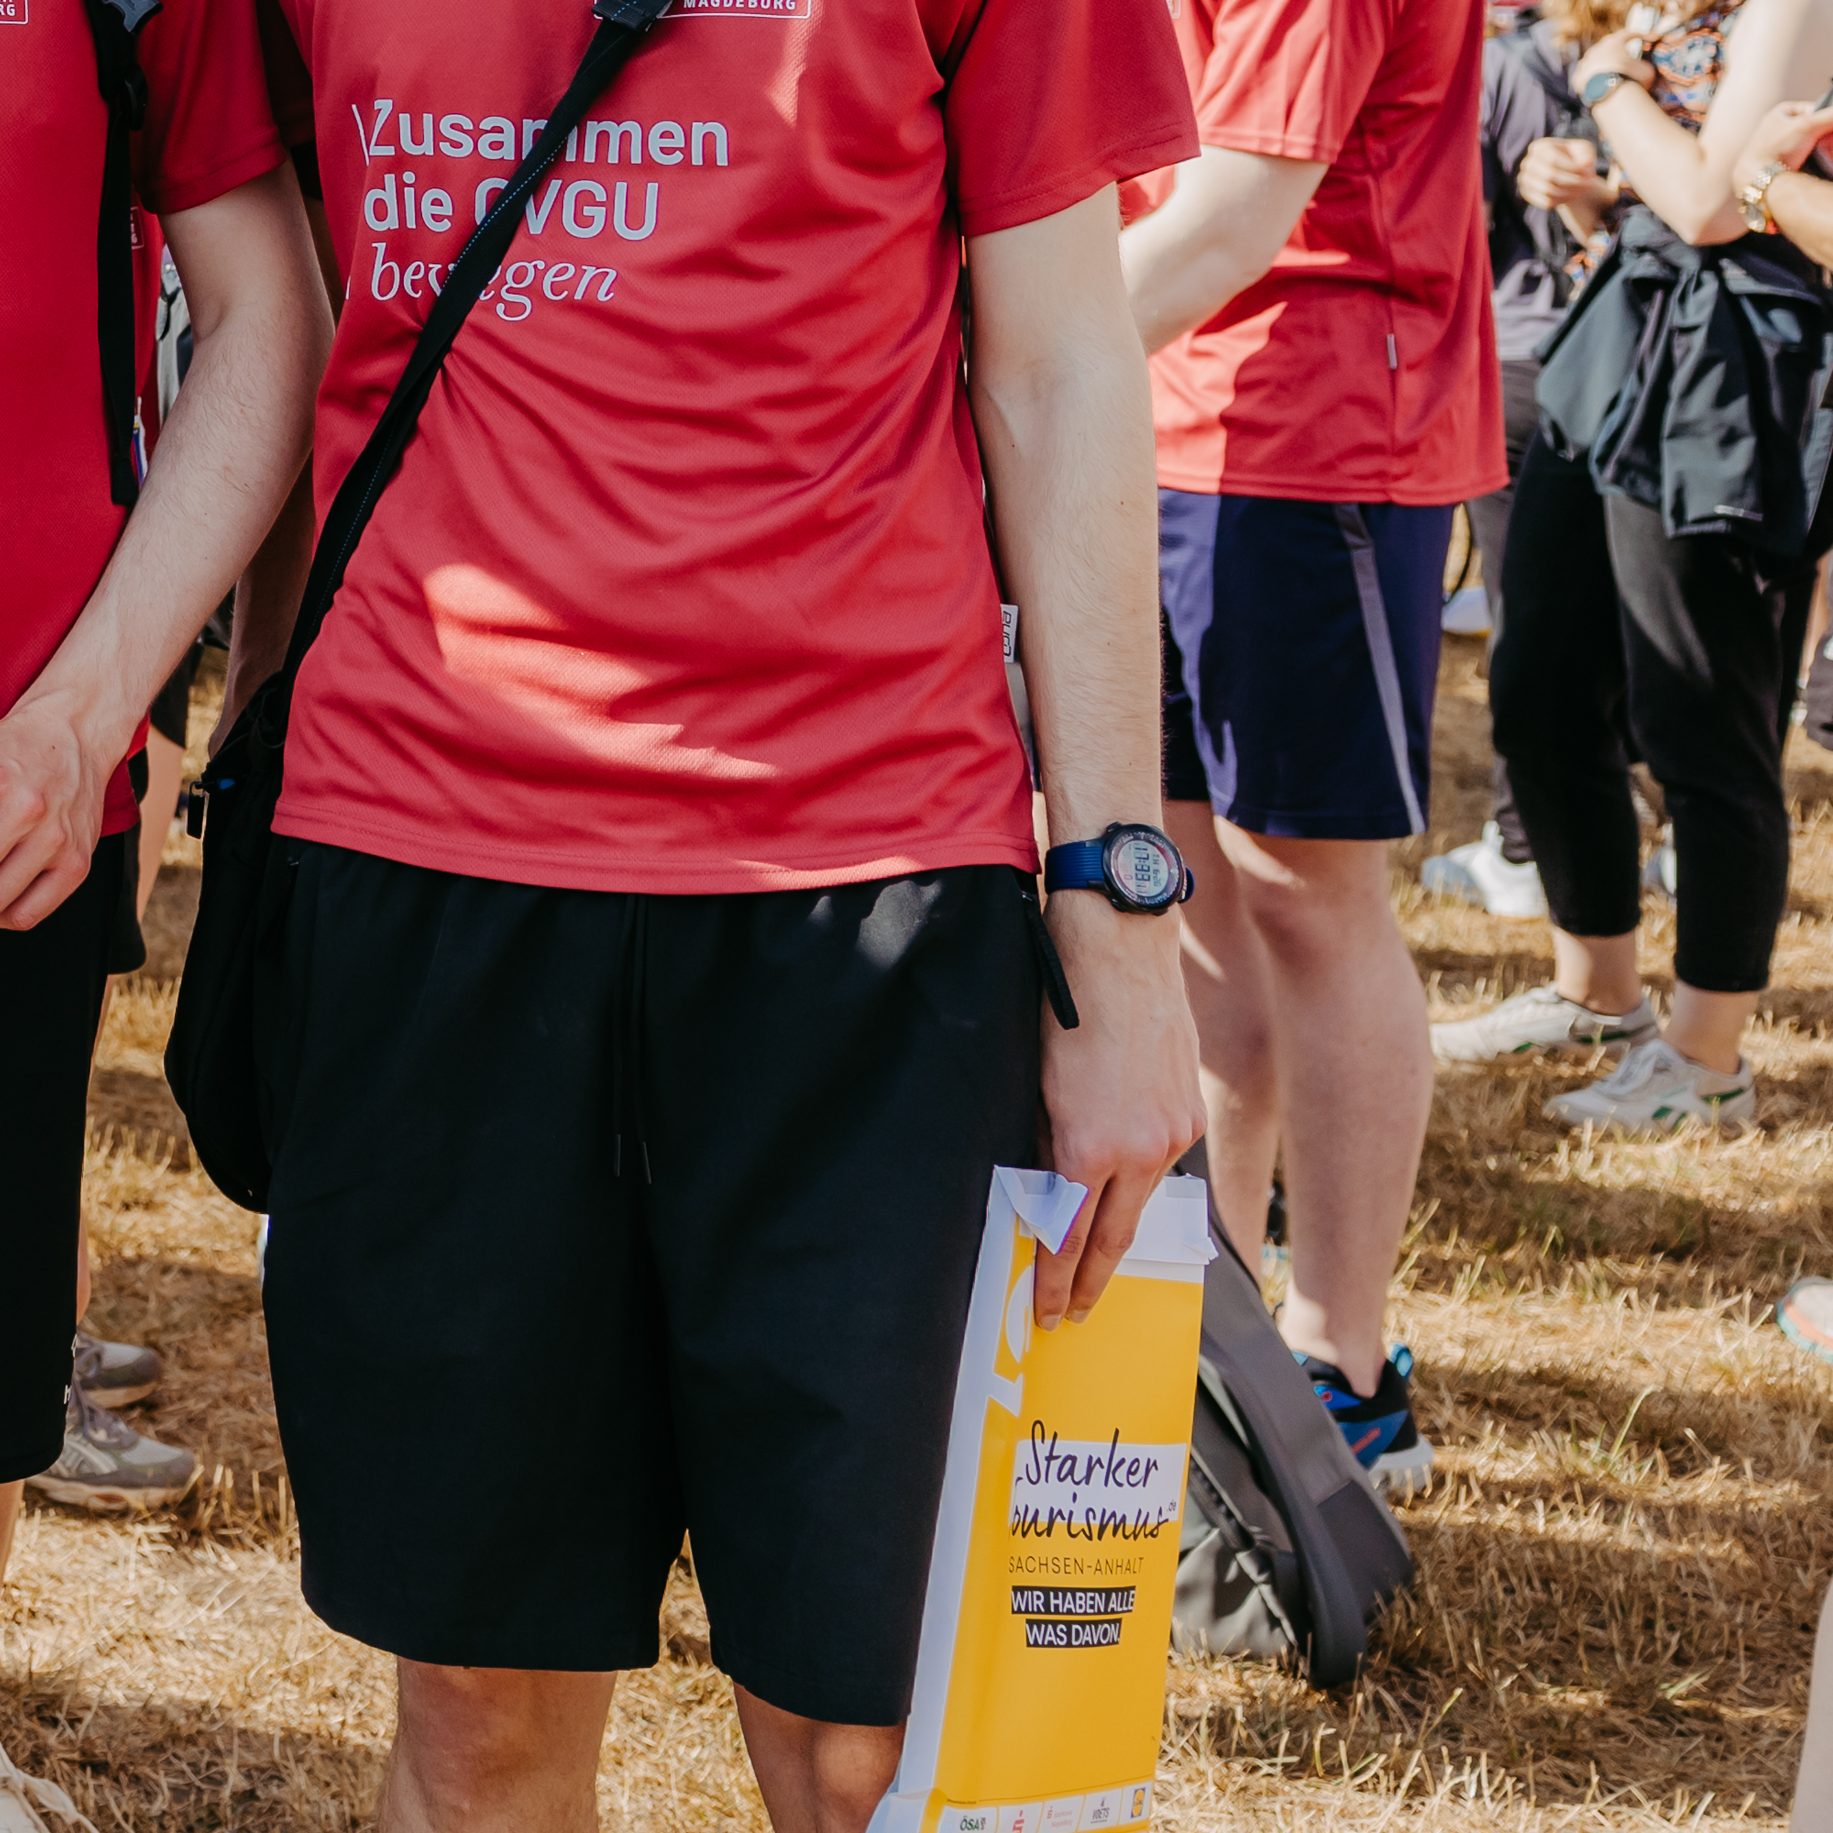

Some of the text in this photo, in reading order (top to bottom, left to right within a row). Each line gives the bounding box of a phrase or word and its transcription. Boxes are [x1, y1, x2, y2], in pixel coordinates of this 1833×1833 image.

[363, 171, 453, 233] die
[1025, 1419, 1159, 1488] Starker
[1008, 1555, 1145, 1576] SACHSEN-ANHALT
[1012, 1590, 1135, 1614] WIR HABEN ALLE
[1026, 1622, 1121, 1646] WAS DAVON.
[959, 1815, 980, 1832] ÖSA
